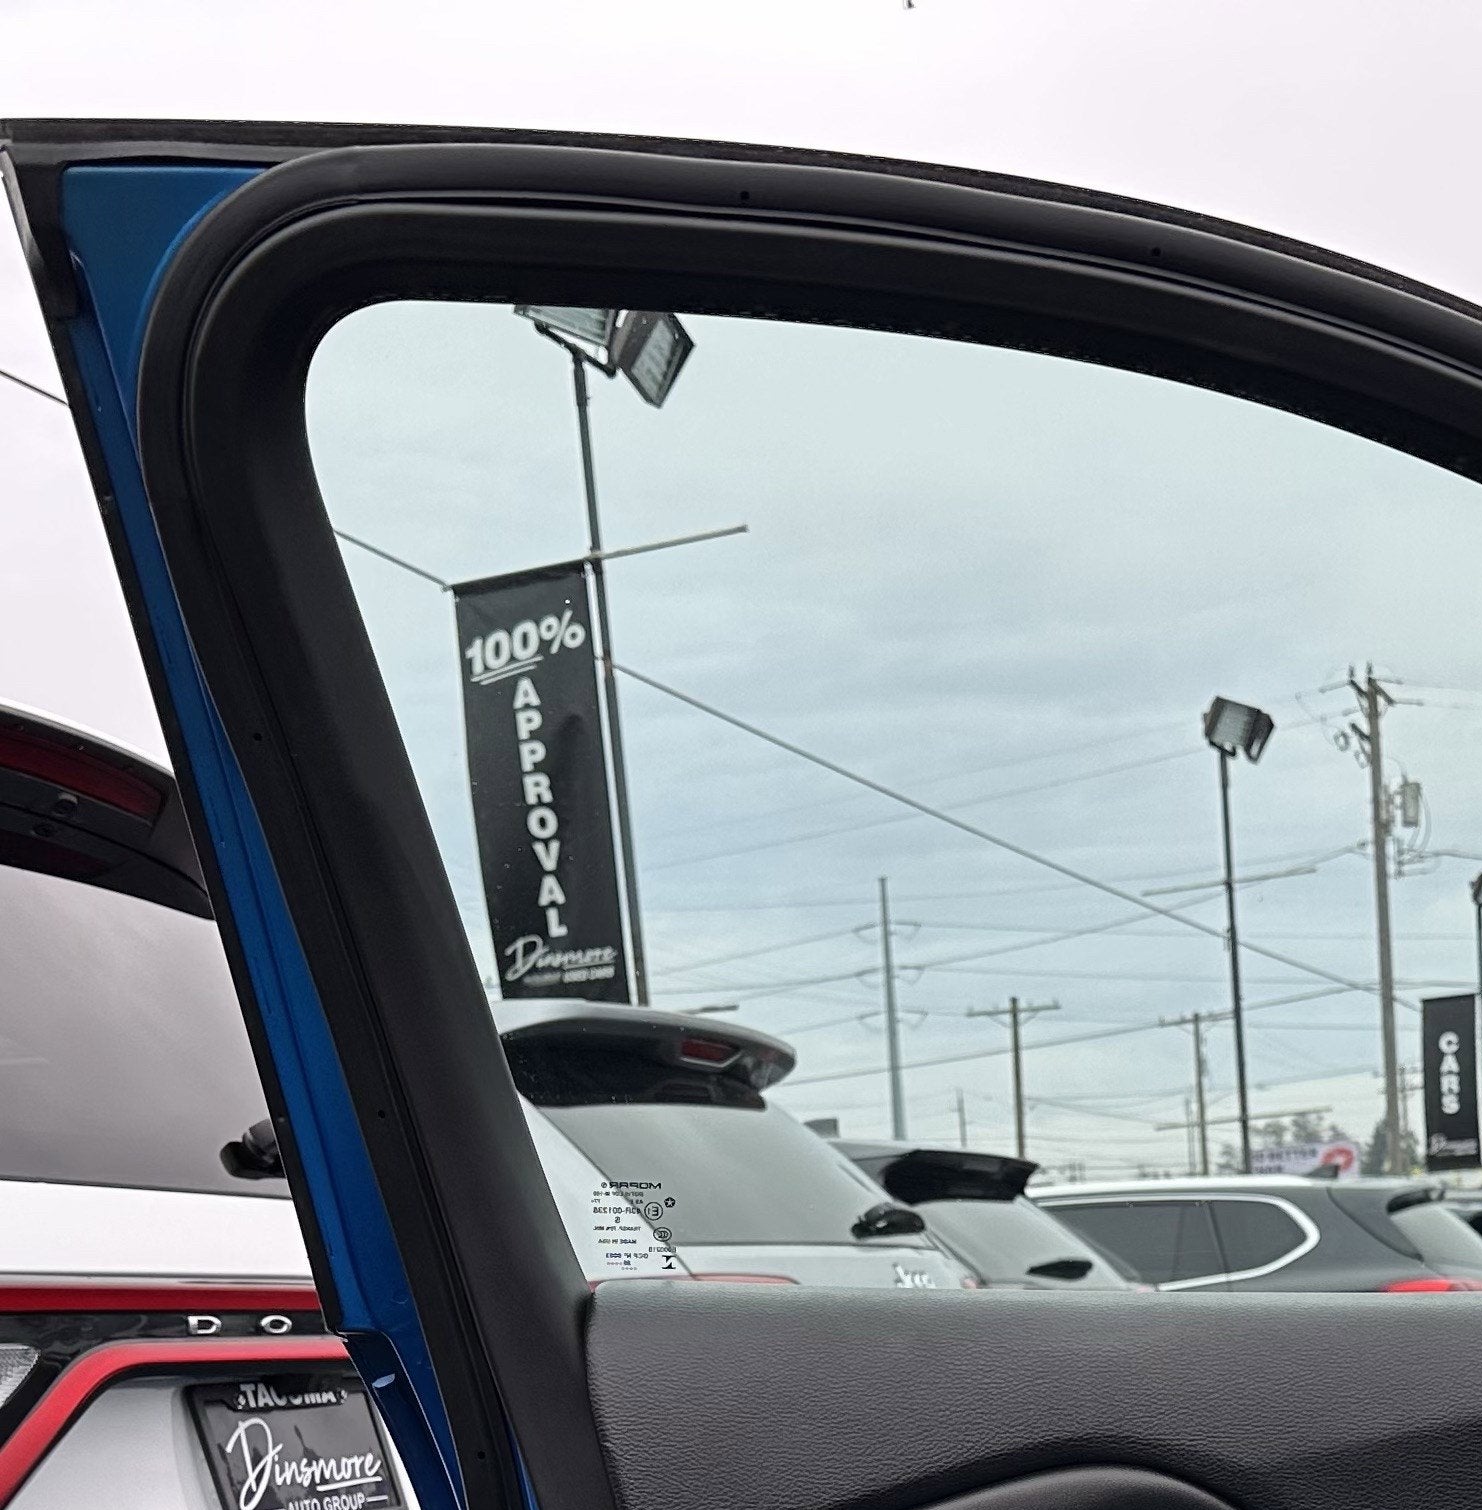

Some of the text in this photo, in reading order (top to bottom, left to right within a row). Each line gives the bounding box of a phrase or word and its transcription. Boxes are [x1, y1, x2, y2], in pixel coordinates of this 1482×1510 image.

[465, 609, 586, 675] 100%
[513, 677, 568, 938] APPROVAL
[1439, 1031, 1460, 1115] CARS
